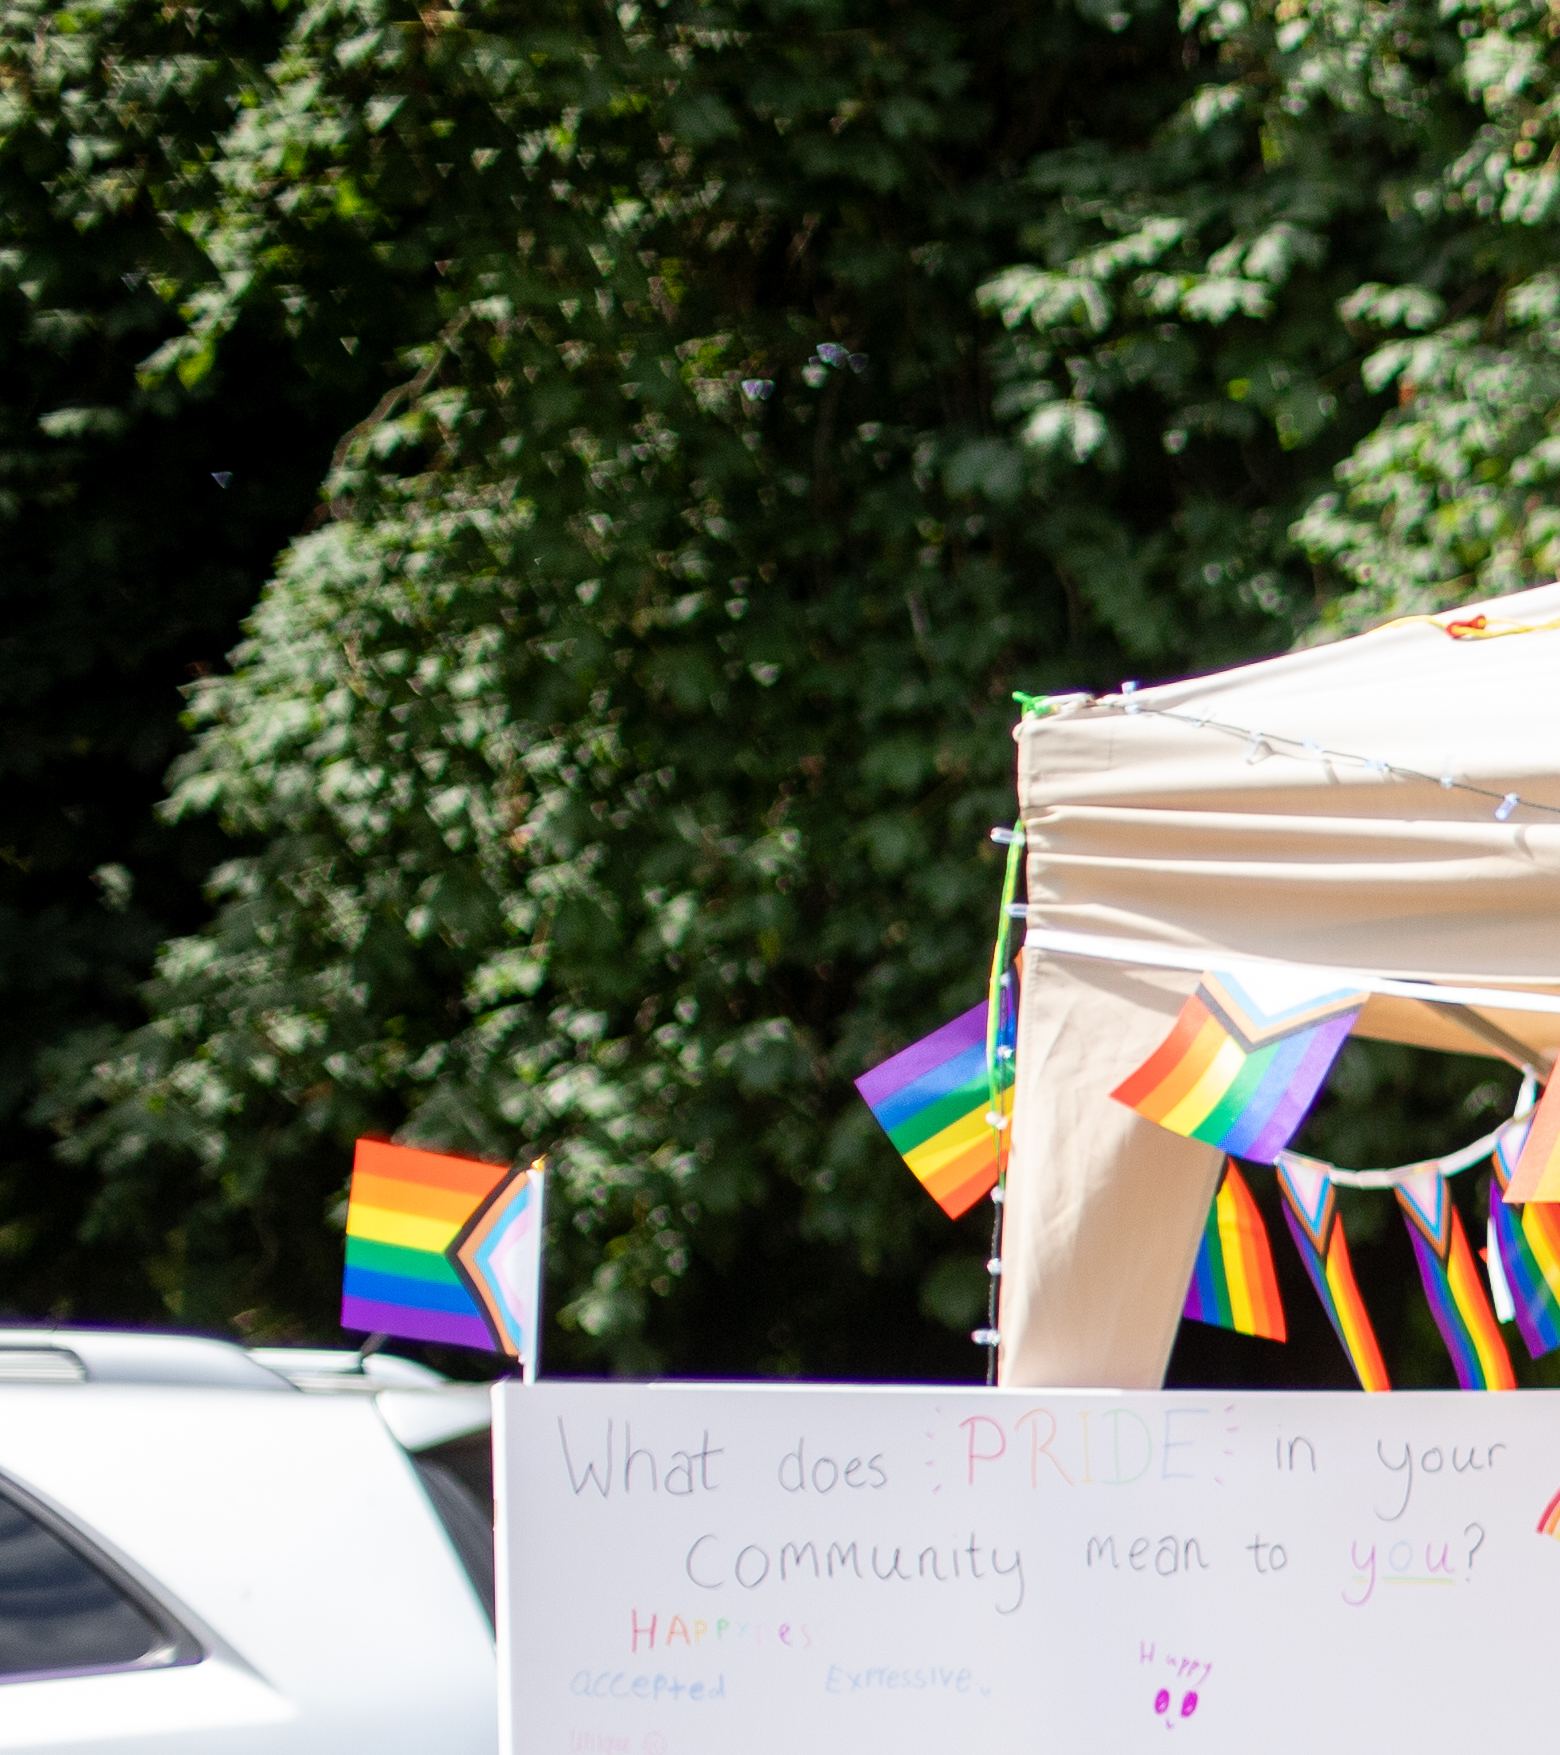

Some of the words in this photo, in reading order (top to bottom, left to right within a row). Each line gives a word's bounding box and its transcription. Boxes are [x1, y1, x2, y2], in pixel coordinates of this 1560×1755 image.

[557, 1415, 725, 1498] What
[777, 1436, 889, 1494] does
[958, 1407, 1210, 1488] PRIDE
[1275, 1422, 1317, 1473] in
[1374, 1436, 1506, 1522] your
[1085, 1534, 1210, 1577] mean
[1245, 1532, 1288, 1575] to
[1341, 1522, 1487, 1607] you?
